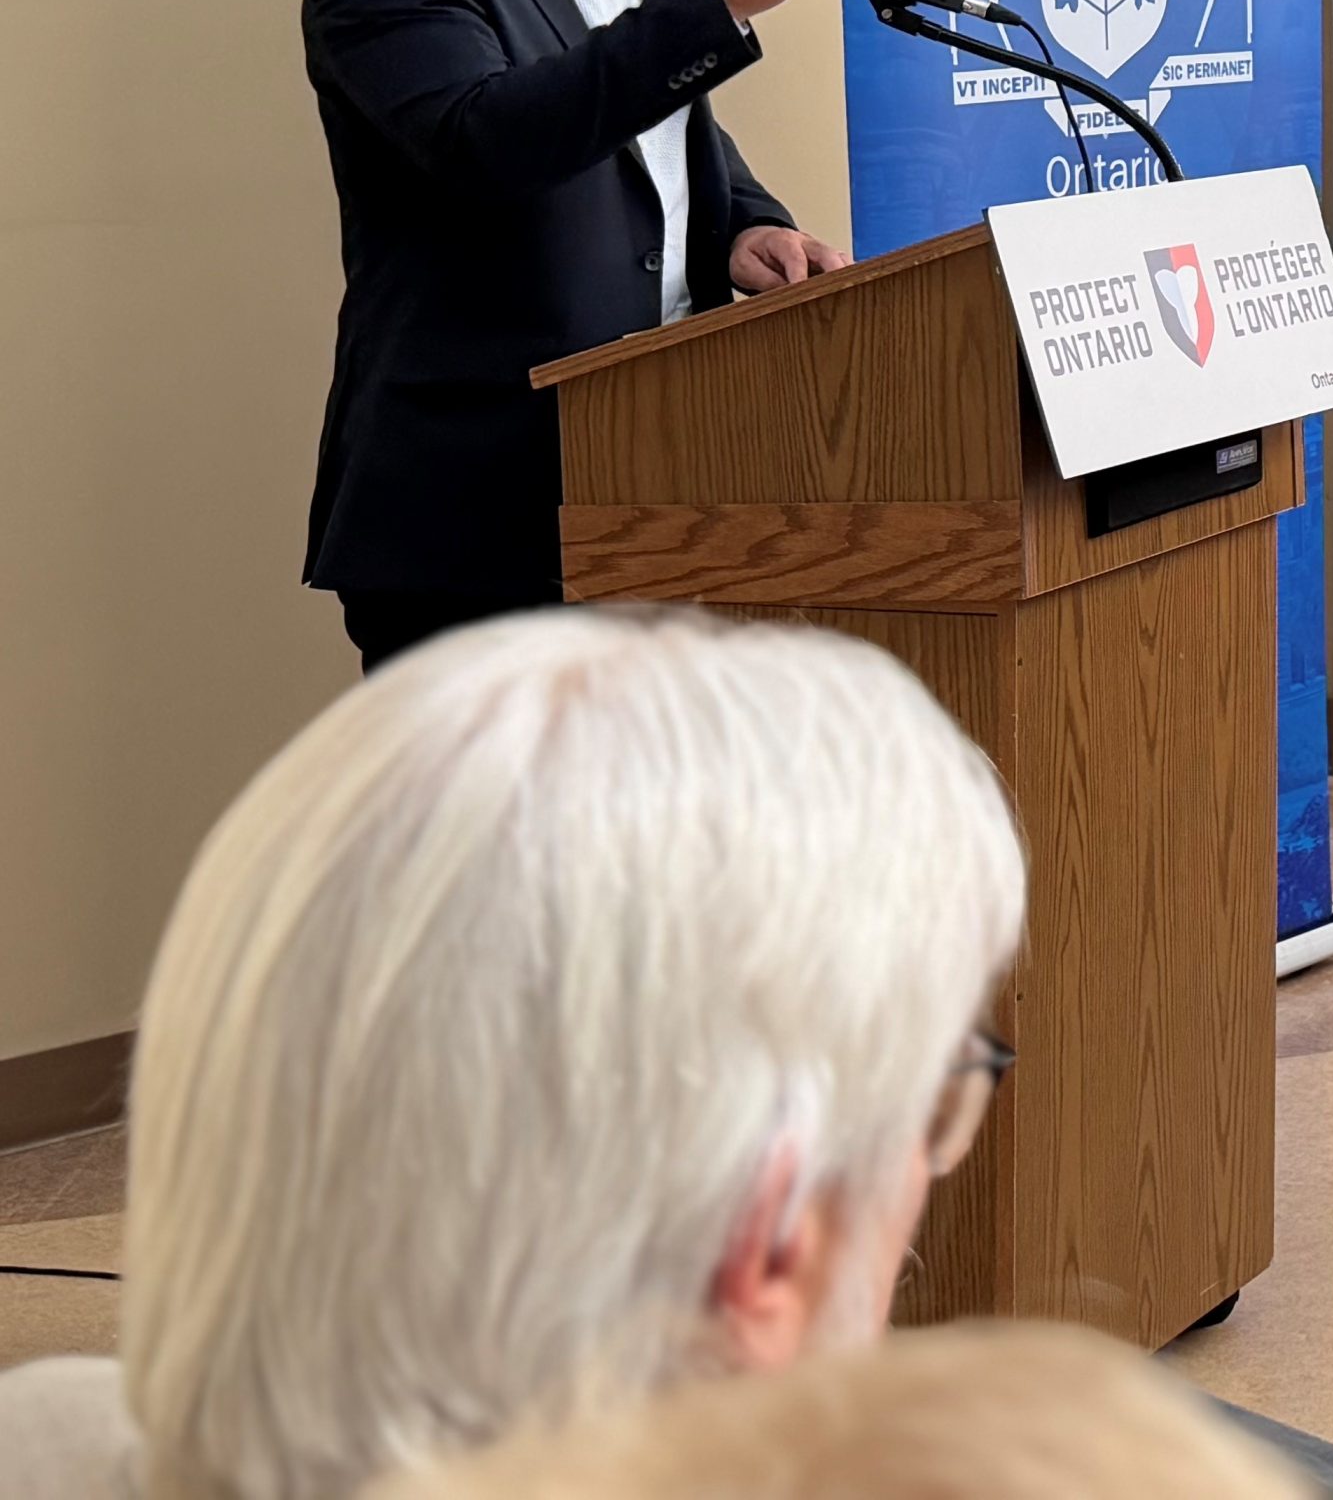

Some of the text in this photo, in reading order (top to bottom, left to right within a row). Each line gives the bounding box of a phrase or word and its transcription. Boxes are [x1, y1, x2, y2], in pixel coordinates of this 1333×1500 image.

[957, 80, 977, 97] VT
[1162, 59, 1251, 81] SIC PERMANET
[1077, 108, 1140, 129] FIDEL
[1213, 240, 1326, 293] PROTÉGER
[1029, 274, 1140, 329] PROTECT
[1043, 321, 1153, 377] ONTARIO
